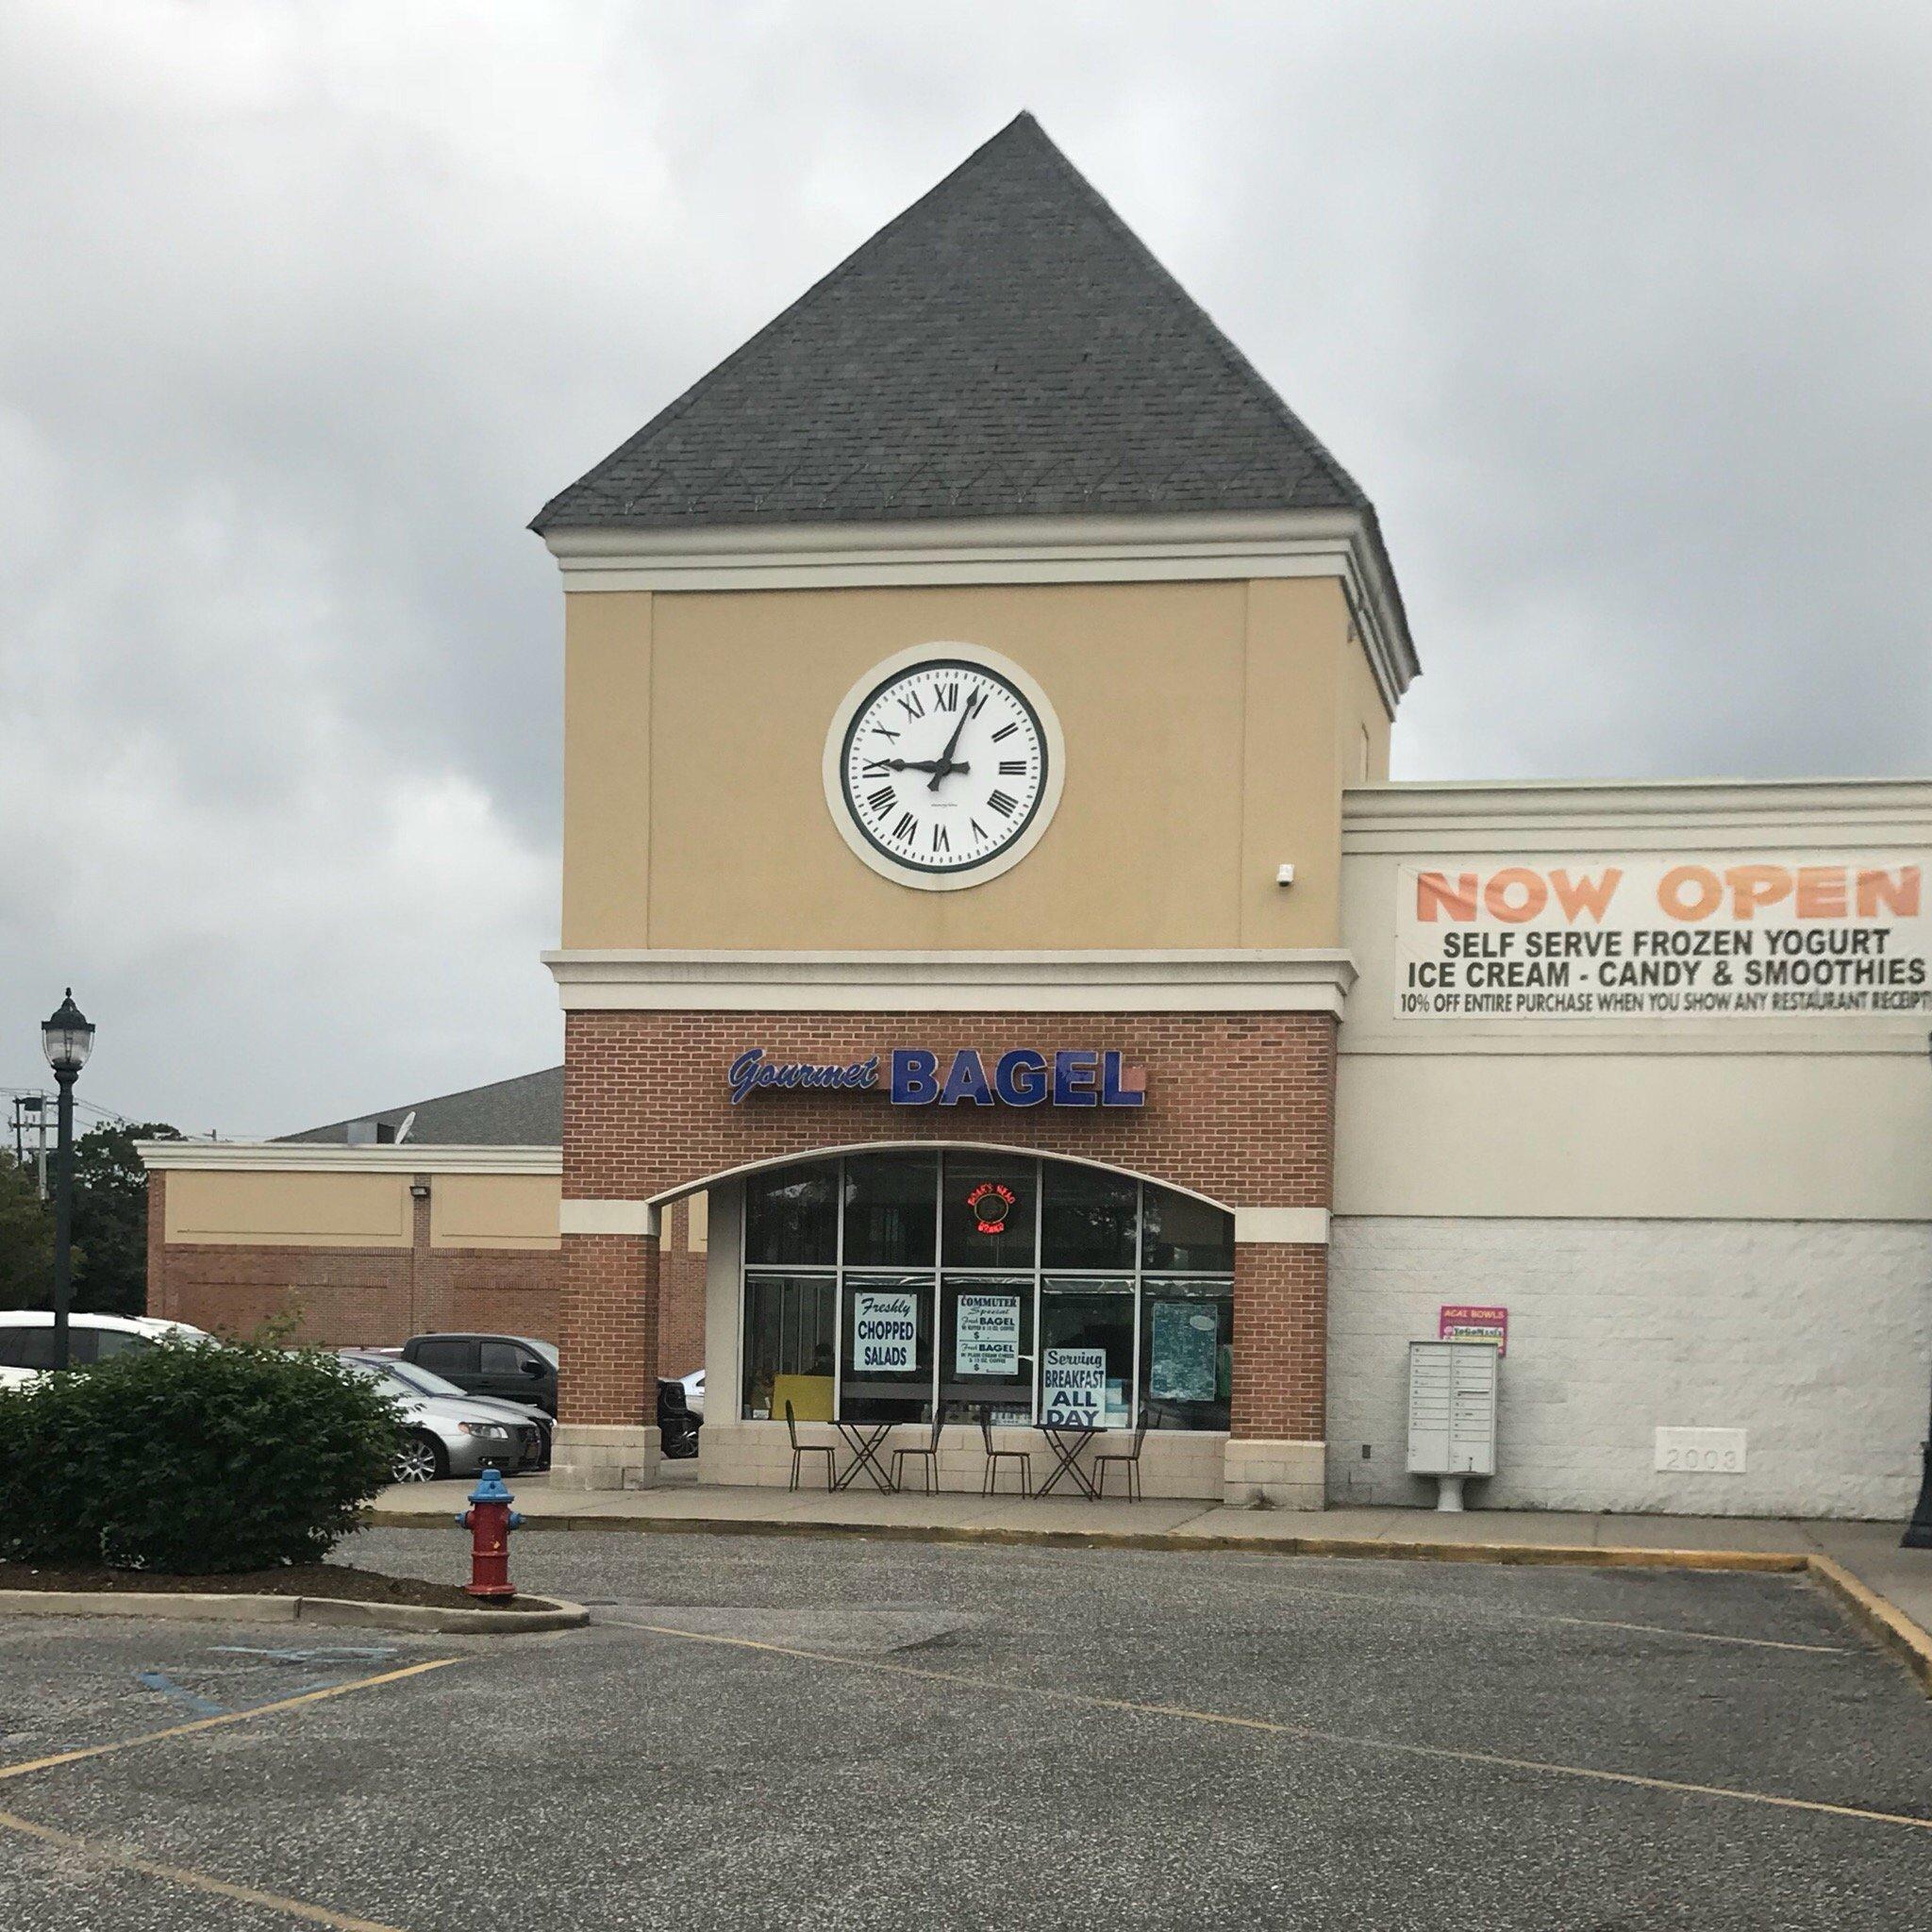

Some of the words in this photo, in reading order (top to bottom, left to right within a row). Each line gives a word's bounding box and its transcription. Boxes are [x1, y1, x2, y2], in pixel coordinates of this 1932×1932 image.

[897, 691, 924, 724] XI
[934, 683, 958, 712] XII
[872, 721, 900, 745] X
[1417, 866, 1624, 925] NOW
[1657, 864, 1921, 922] OPEN
[1443, 931, 1515, 958] SELF
[1525, 931, 1622, 958] SERVE
[1633, 929, 1753, 957] FROZEN
[1764, 927, 1890, 956] YOGURT
[1408, 961, 1457, 989] ICE
[1466, 961, 1570, 988] CREAM
[1598, 959, 1701, 987] CANDY
[1712, 959, 1733, 986] &
[1745, 958, 1926, 986] SMOOTHIES
[1401, 993, 1430, 1013] 10%
[1434, 993, 1461, 1013] OFF
[1464, 993, 1513, 1013] ENTIRE
[1516, 992, 1594, 1013] PURCHASE
[1597, 992, 1645, 1012] WHEN
[1650, 992, 1679, 1012] YOU
[1684, 992, 1730, 1011] SHOW
[1735, 991, 1767, 1011] ANY
[1772, 991, 1868, 1011] RESTAURANT
[728, 1048, 880, 1105] Gourmet
[891, 1048, 1145, 1107] BAGEL
[861, 1297, 911, 1318] Freshly
[960, 1297, 1017, 1307] COMMUTER
[979, 1317, 1015, 1325] BAGEL
[1471, 1309, 1505, 1319] BOWLS
[858, 1320, 914, 1341] CHOPPED
[864, 1346, 908, 1366] SALADS
[1047, 1350, 1103, 1368] Serving
[1044, 1370, 1105, 1389] BREAKFAST
[1052, 1391, 1097, 1407] ALL
[1047, 1409, 1100, 1426] DAY
